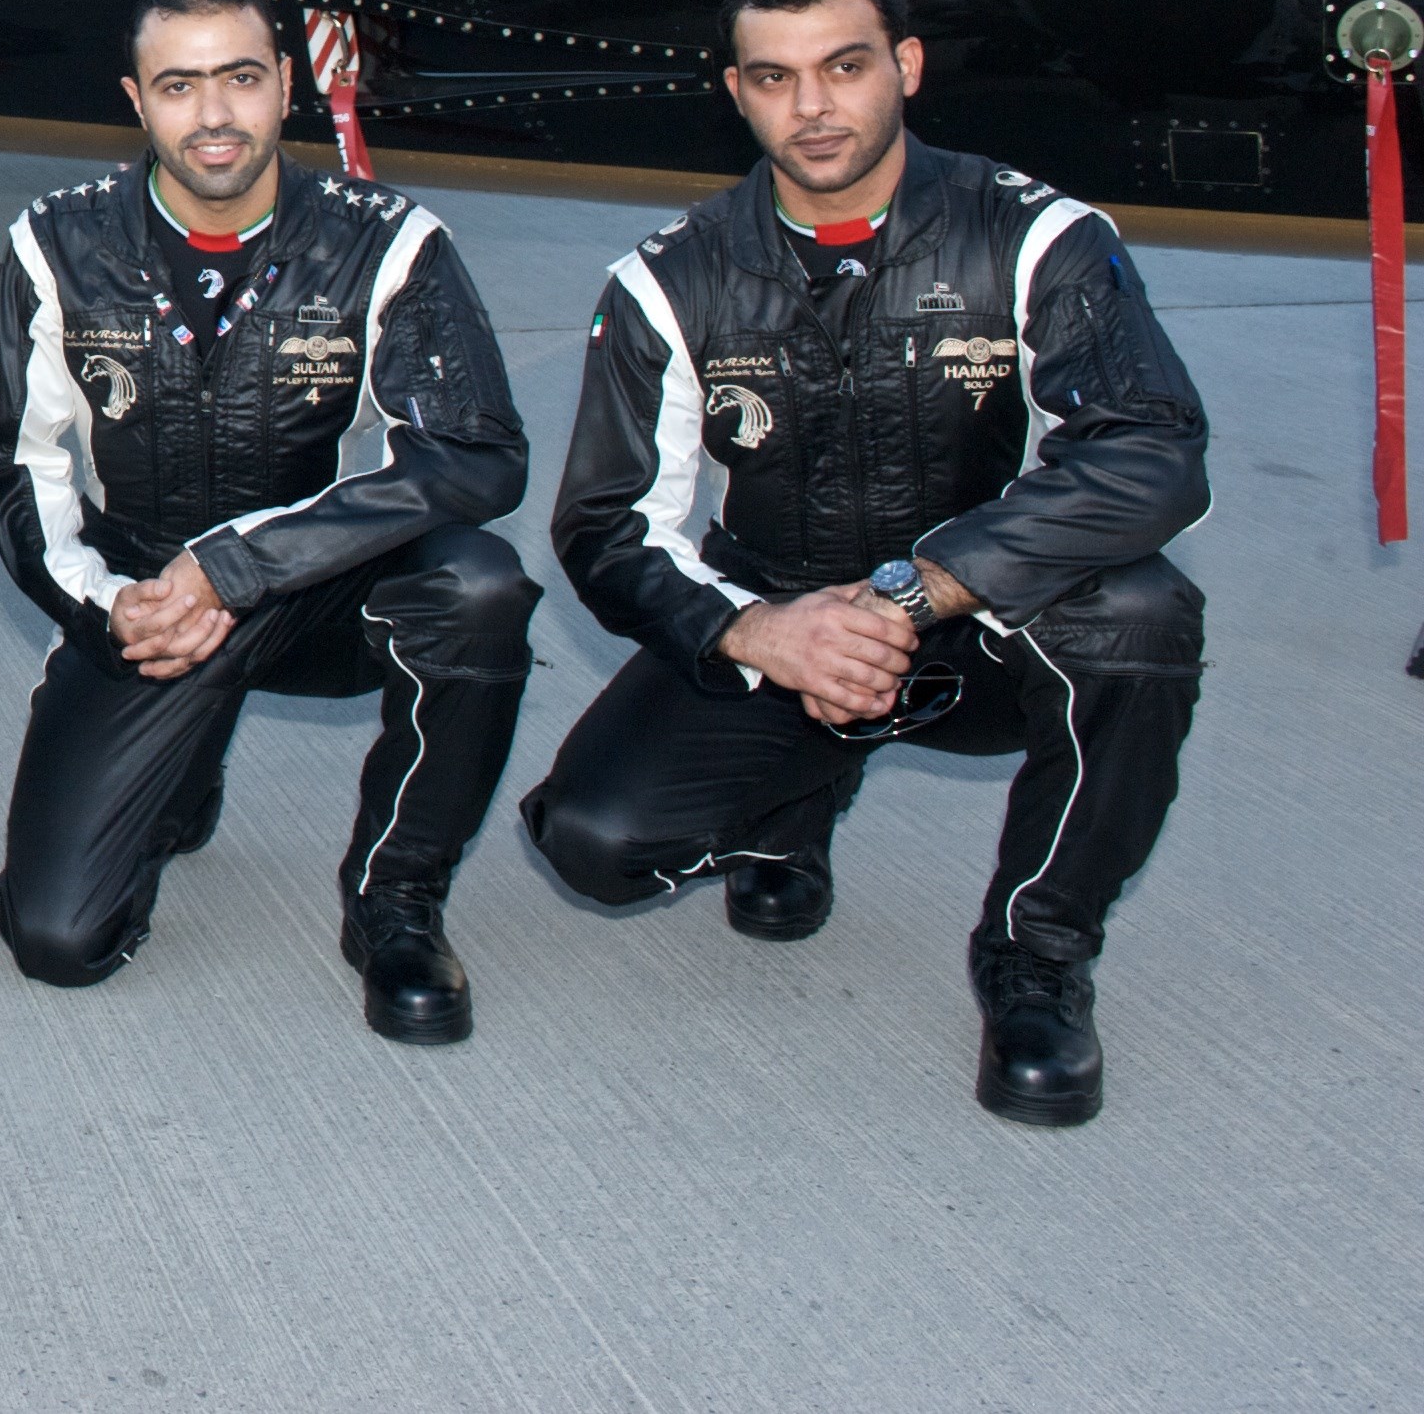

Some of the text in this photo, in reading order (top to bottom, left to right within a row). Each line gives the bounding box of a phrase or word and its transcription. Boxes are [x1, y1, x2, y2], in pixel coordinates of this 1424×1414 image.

[292, 362, 339, 374] SULTAN
[944, 364, 1011, 379] HAMAD
[287, 376, 309, 385] LEFT
[964, 380, 994, 389] SOLO
[305, 386, 321, 405] 4
[971, 390, 987, 411] 7
